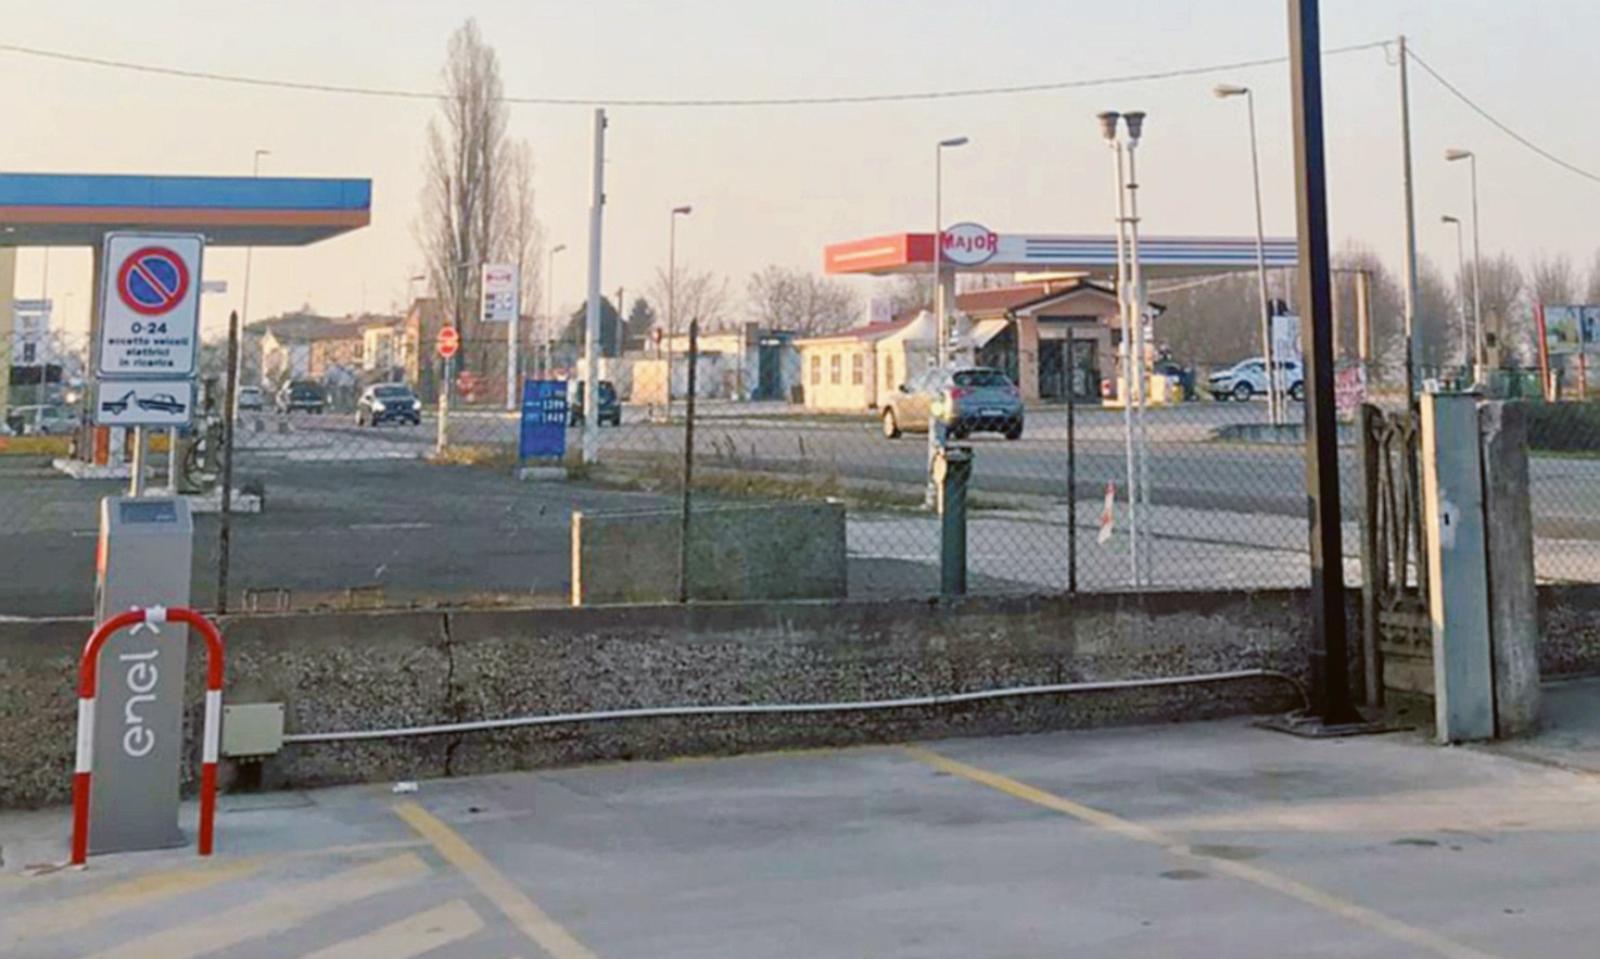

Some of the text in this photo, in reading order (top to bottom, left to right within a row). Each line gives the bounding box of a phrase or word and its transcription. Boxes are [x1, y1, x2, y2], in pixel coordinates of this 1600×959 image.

[939, 232, 998, 255] MAJOR
[131, 322, 167, 334] 0-24
[119, 650, 160, 757] enel
